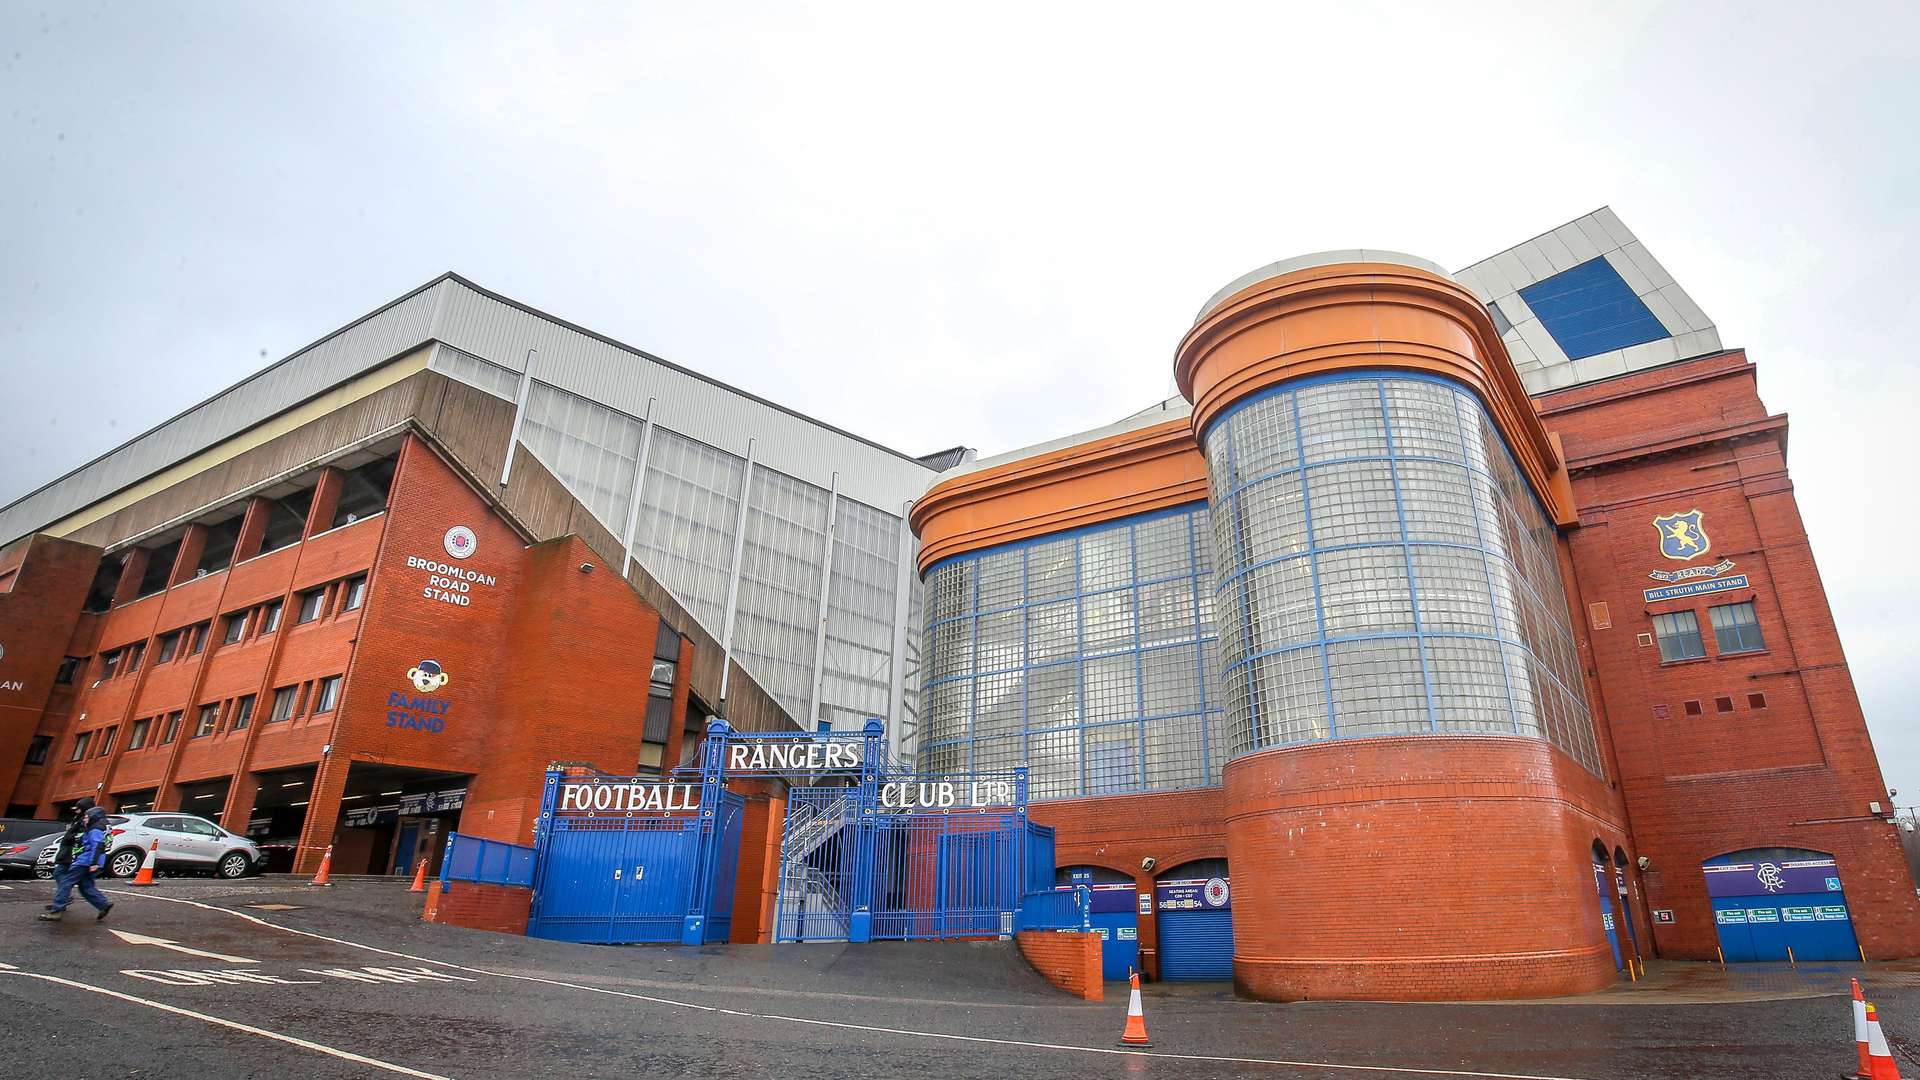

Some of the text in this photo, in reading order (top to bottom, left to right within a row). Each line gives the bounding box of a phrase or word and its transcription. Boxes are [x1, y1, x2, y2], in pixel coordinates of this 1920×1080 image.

[407, 556, 496, 586] BROOMLOAN
[430, 575, 470, 593] ROAD
[1649, 579, 1743, 599] BILL STRUTH MAIN STAND
[423, 587, 470, 606] STAND
[387, 691, 453, 715] FAMILY
[385, 711, 445, 734] STAND
[729, 743, 859, 770] RANGERS
[560, 784, 699, 811] FOOTBALL
[882, 782, 955, 808] CLUB
[120, 966, 478, 985] ONE WAY
